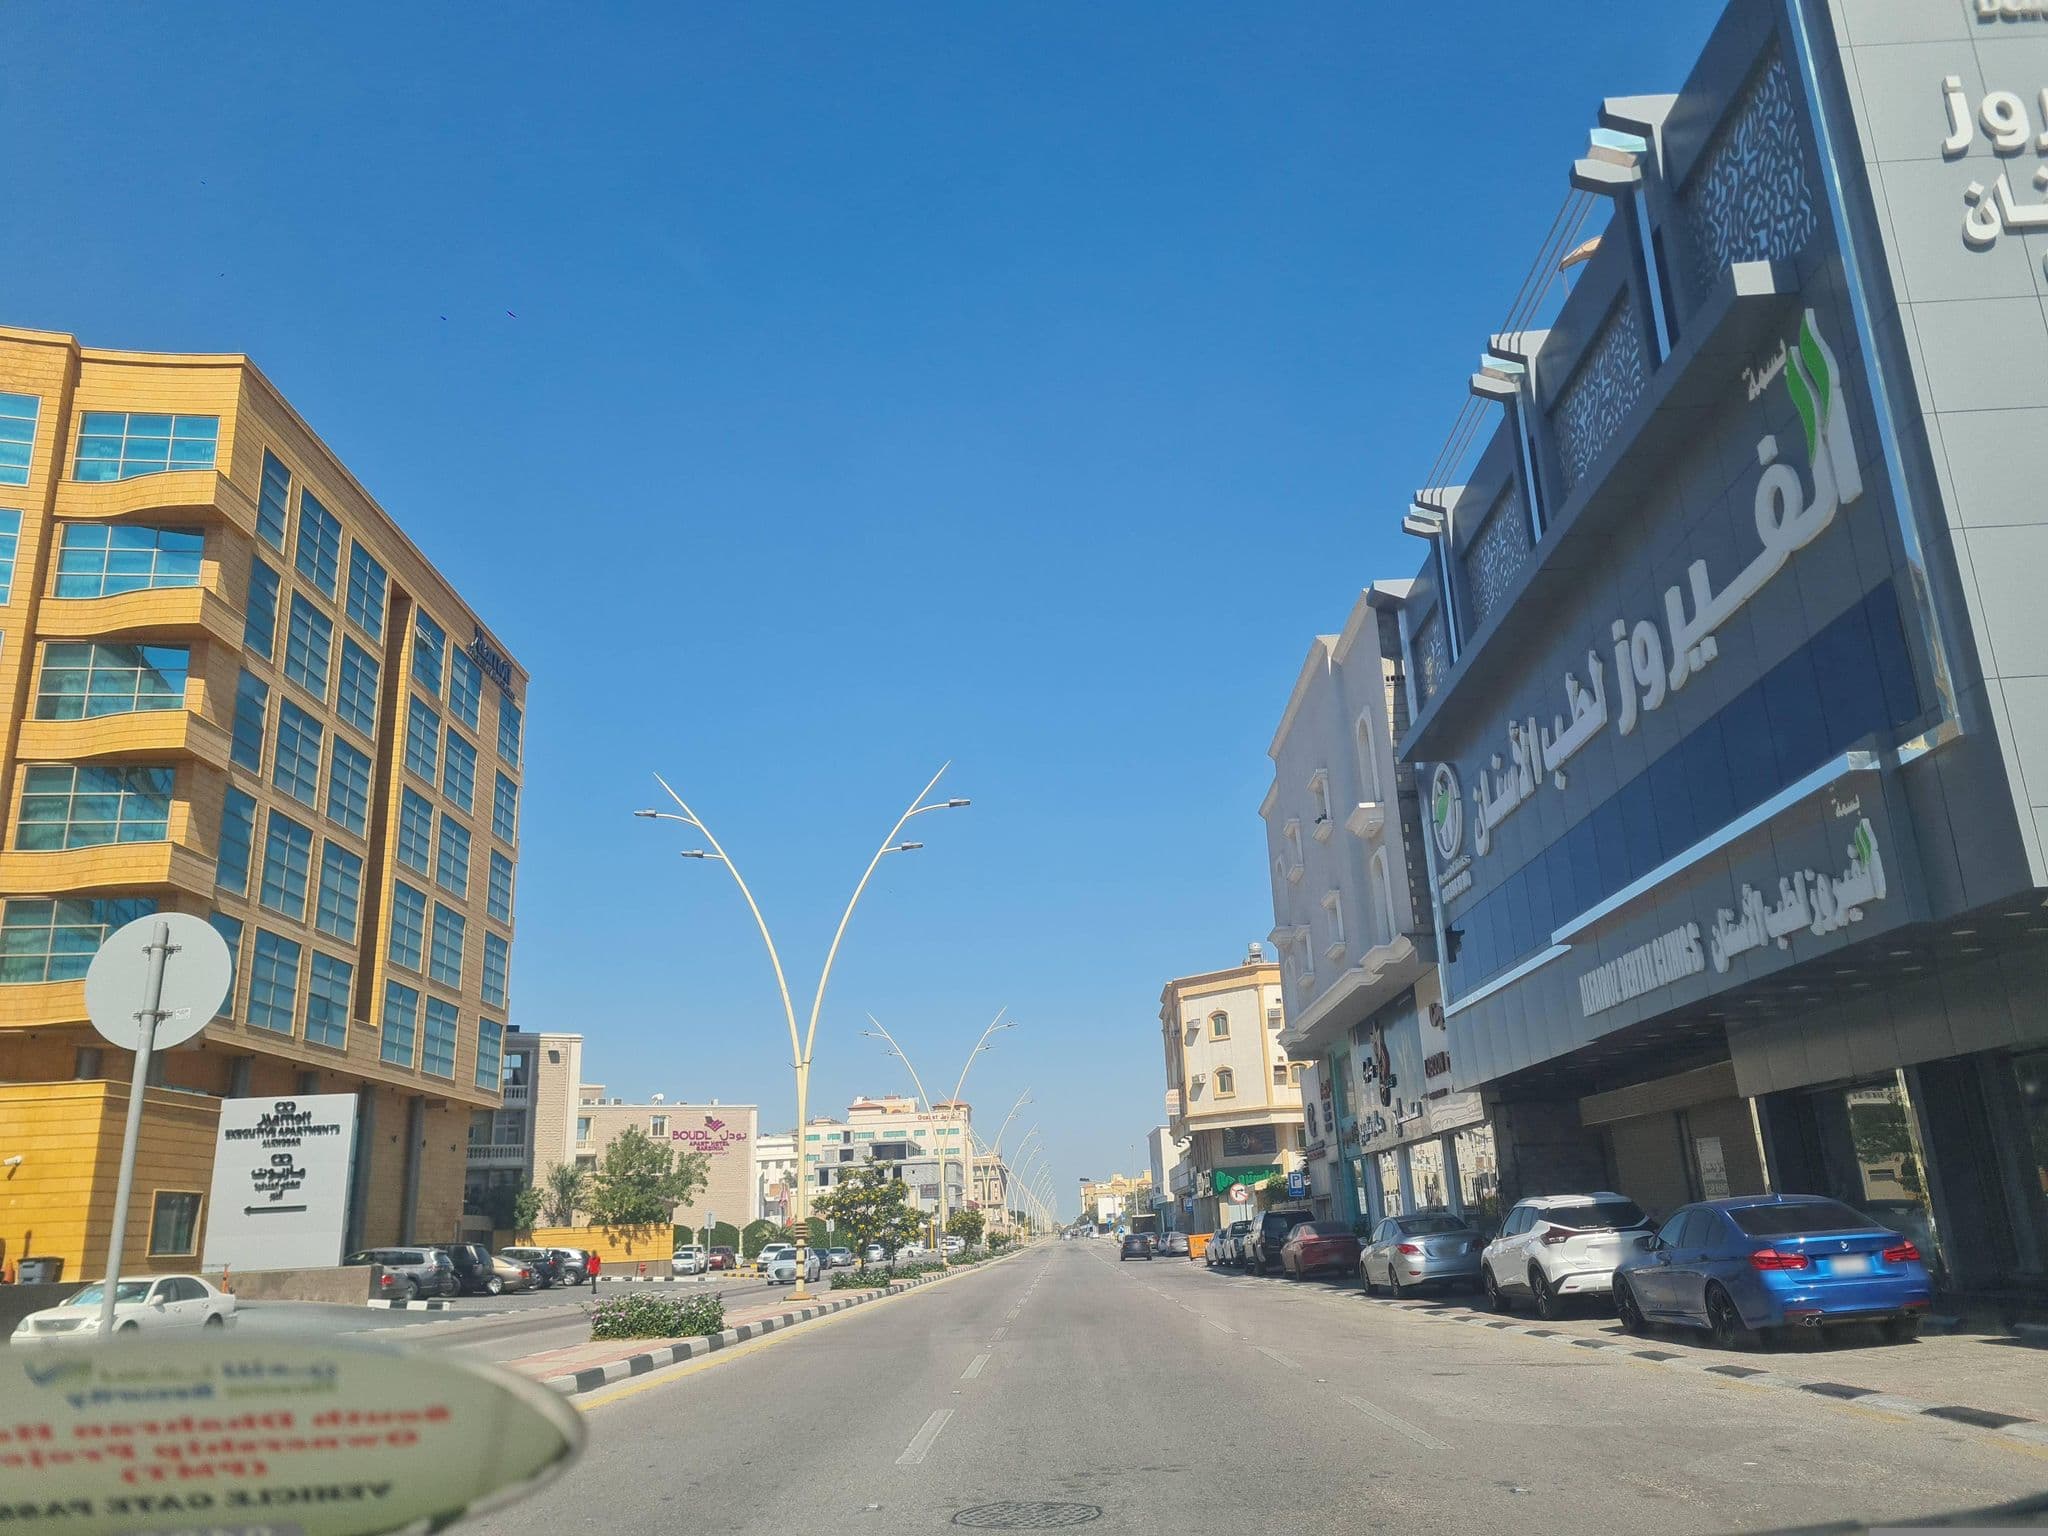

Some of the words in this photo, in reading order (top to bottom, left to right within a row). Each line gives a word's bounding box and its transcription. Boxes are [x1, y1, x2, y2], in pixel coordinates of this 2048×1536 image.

[1612, 308, 1863, 736] الفيروز
[1541, 650, 1608, 790] لطب
[277, 1124, 341, 1138] APARTMENTS
[672, 1130, 712, 1140] BOUDL
[251, 1164, 306, 1181] ماريوت
